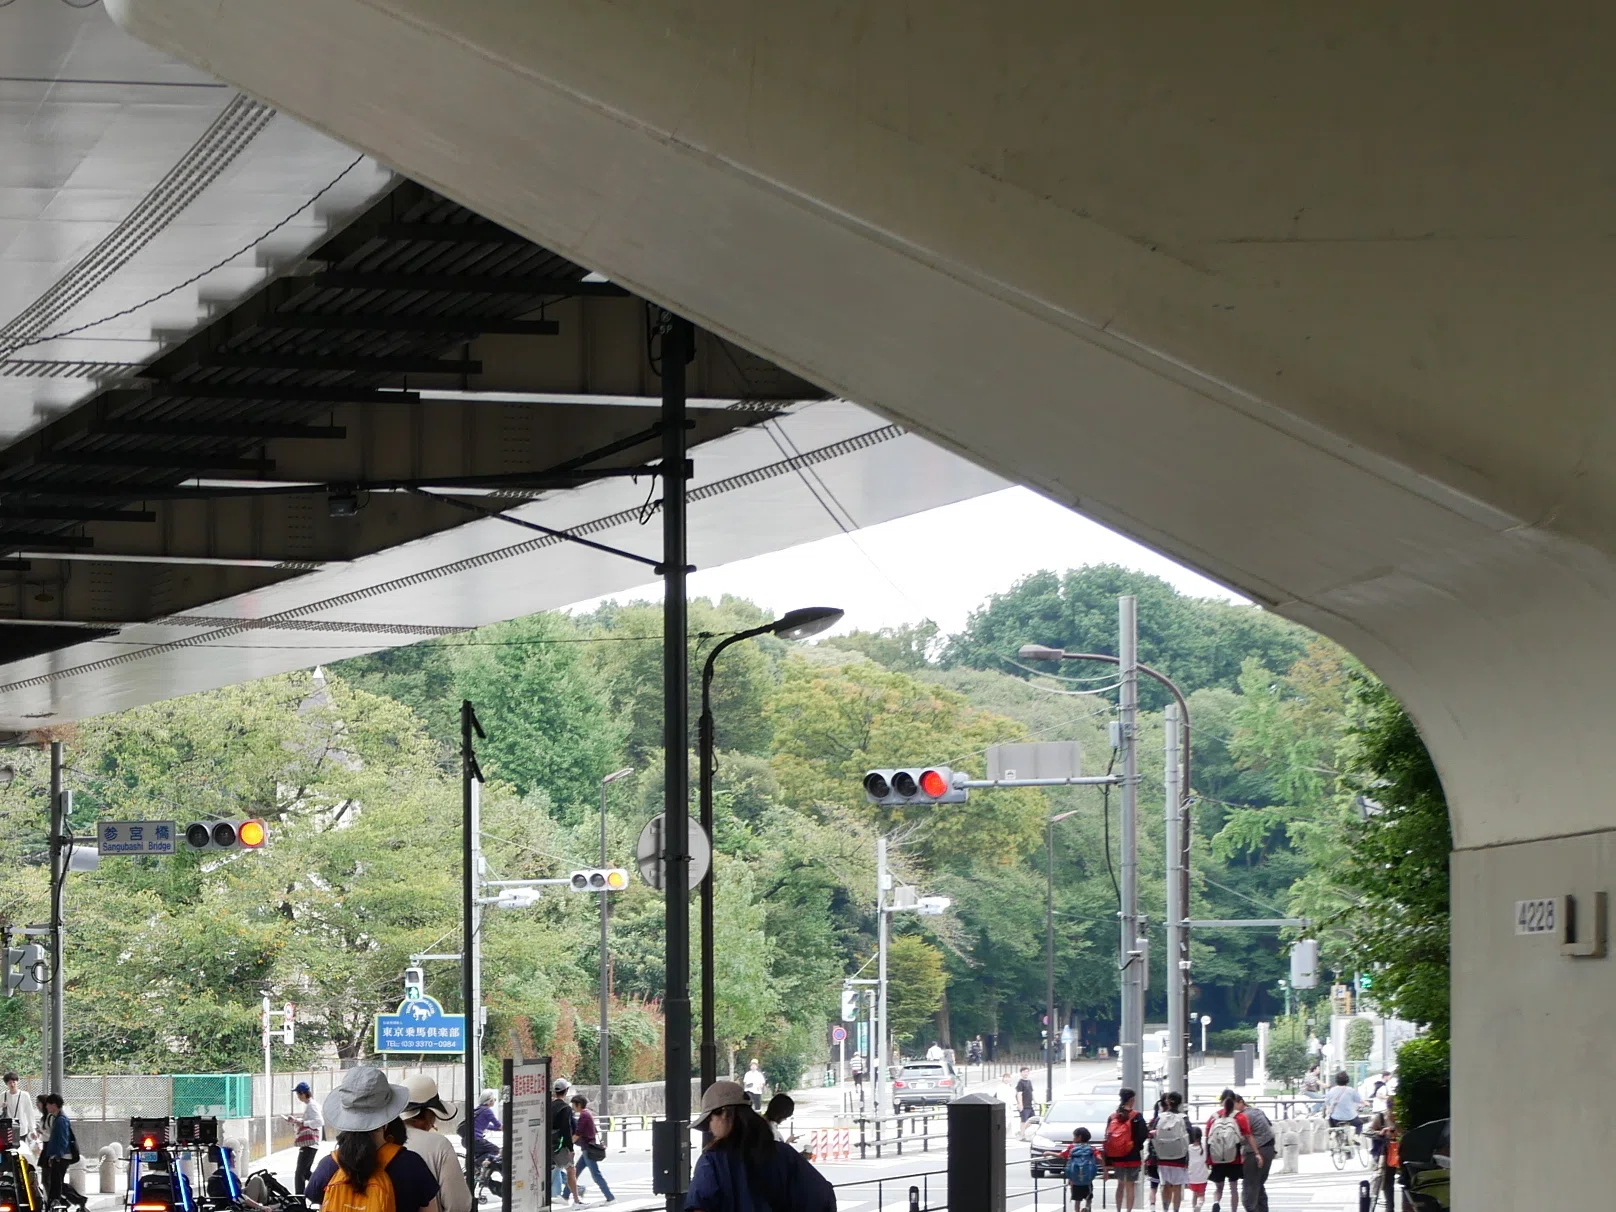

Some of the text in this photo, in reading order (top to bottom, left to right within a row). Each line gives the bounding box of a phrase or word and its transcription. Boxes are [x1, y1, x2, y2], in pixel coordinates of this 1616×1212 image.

[104, 825, 169, 841] 参宮橋
[103, 841, 171, 852] Sangubashi Bridge
[1518, 901, 1553, 932] 4228
